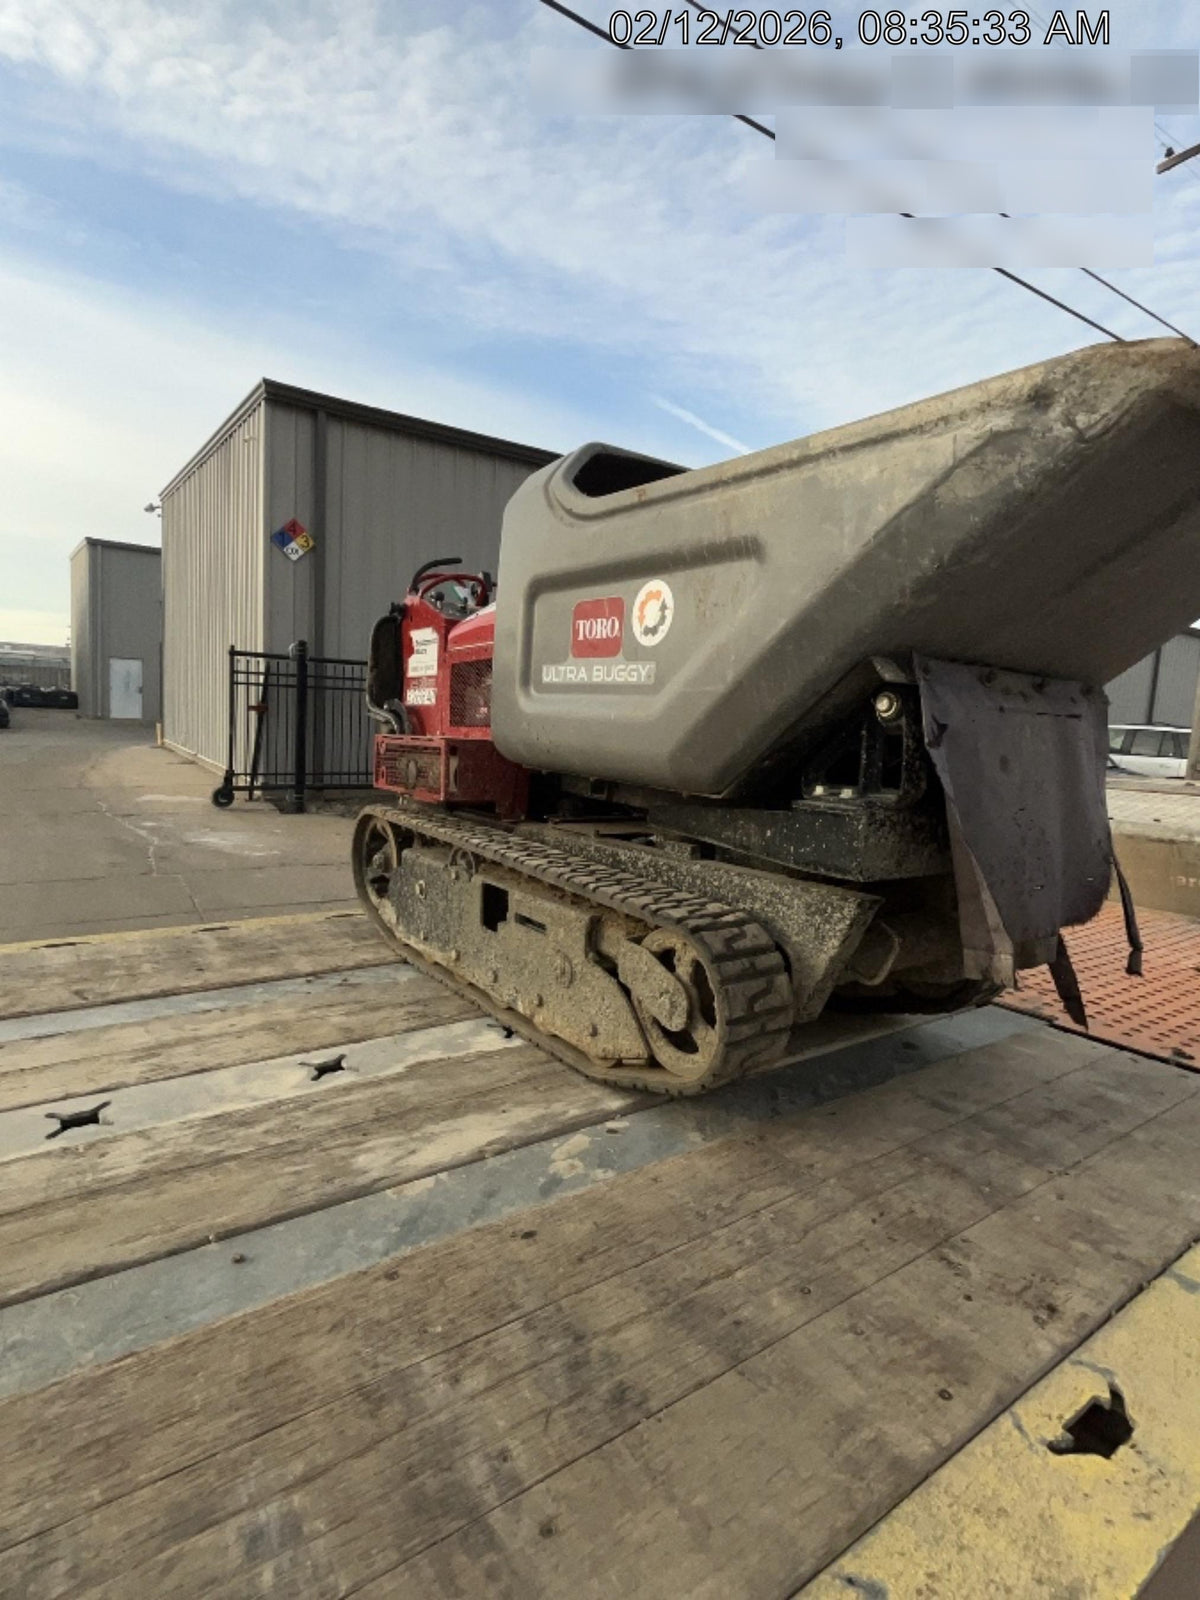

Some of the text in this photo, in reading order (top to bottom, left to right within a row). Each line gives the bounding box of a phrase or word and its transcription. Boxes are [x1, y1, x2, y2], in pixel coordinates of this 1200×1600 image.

[288, 521, 296, 536] 4
[300, 535, 310, 548] 3
[576, 616, 620, 641] TORO
[543, 664, 650, 682] ULTRA BUGGY
